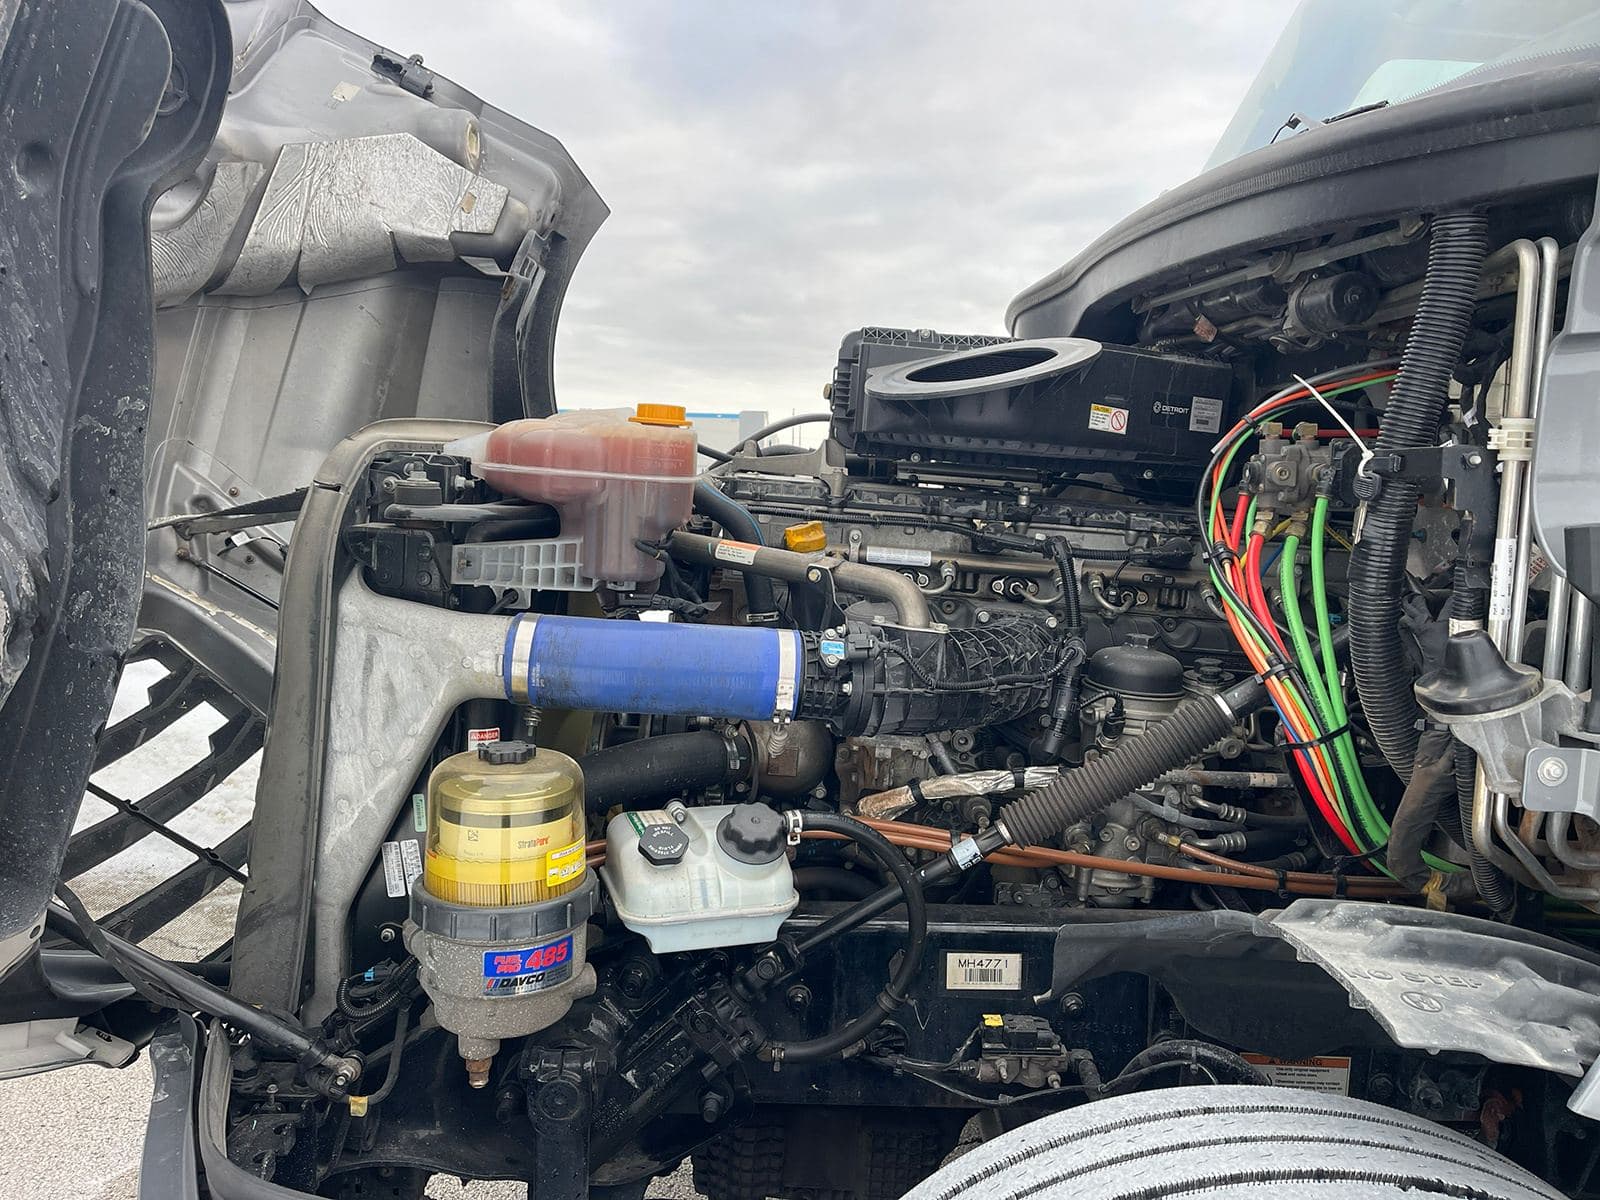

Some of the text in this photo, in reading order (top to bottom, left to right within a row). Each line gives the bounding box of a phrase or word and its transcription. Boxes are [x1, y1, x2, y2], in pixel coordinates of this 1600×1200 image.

[1162, 405, 1190, 414] DETROIT
[477, 730, 499, 741] DANGER
[494, 954, 522, 965] FUEL
[525, 941, 569, 970] 485
[496, 964, 521, 974] PRO
[958, 958, 1008, 969] MH4771
[498, 972, 546, 989] DAVCO
[1340, 966, 1483, 989] NO STEP
